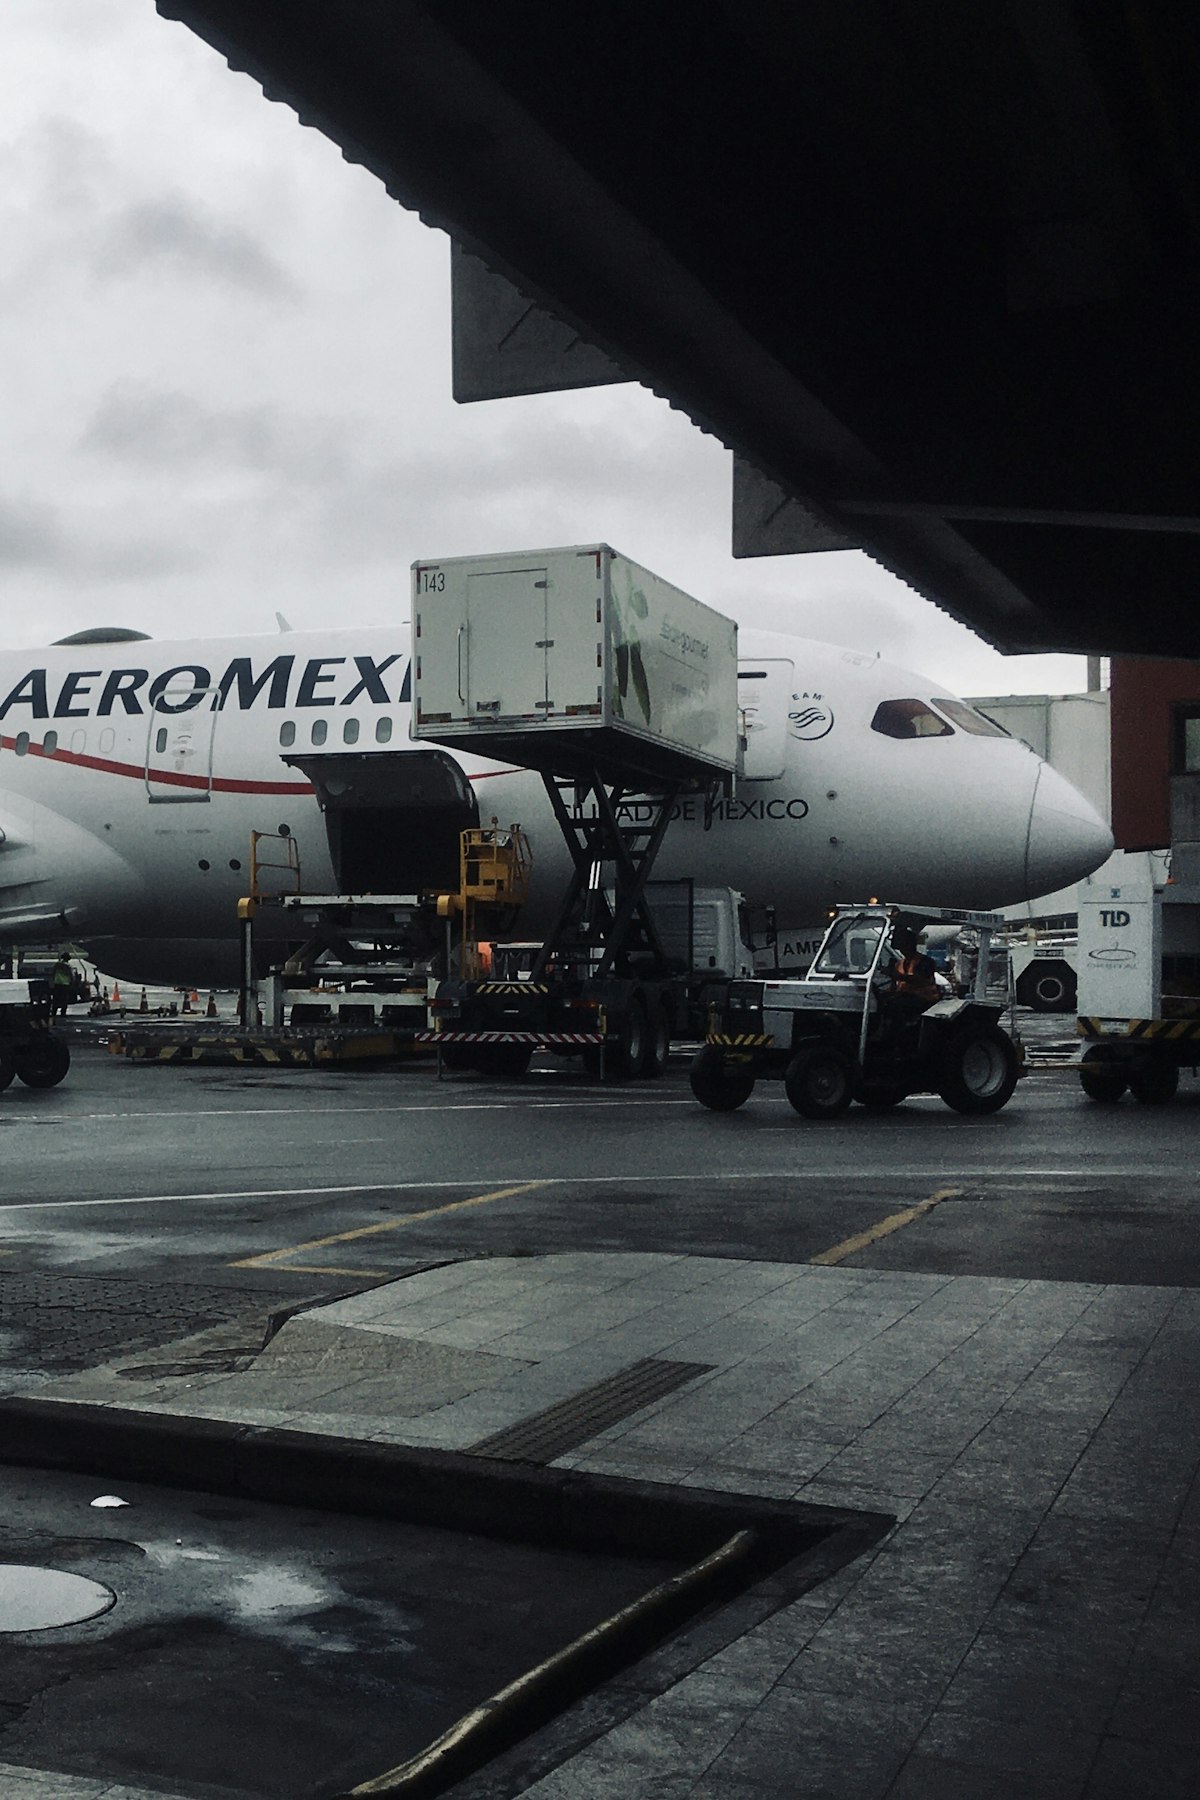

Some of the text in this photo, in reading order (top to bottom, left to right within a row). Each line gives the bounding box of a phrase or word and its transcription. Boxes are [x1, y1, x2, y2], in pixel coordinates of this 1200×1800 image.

[424, 572, 445, 592] 143
[792, 692, 822, 701] EAM
[1100, 910, 1130, 927] TLD
